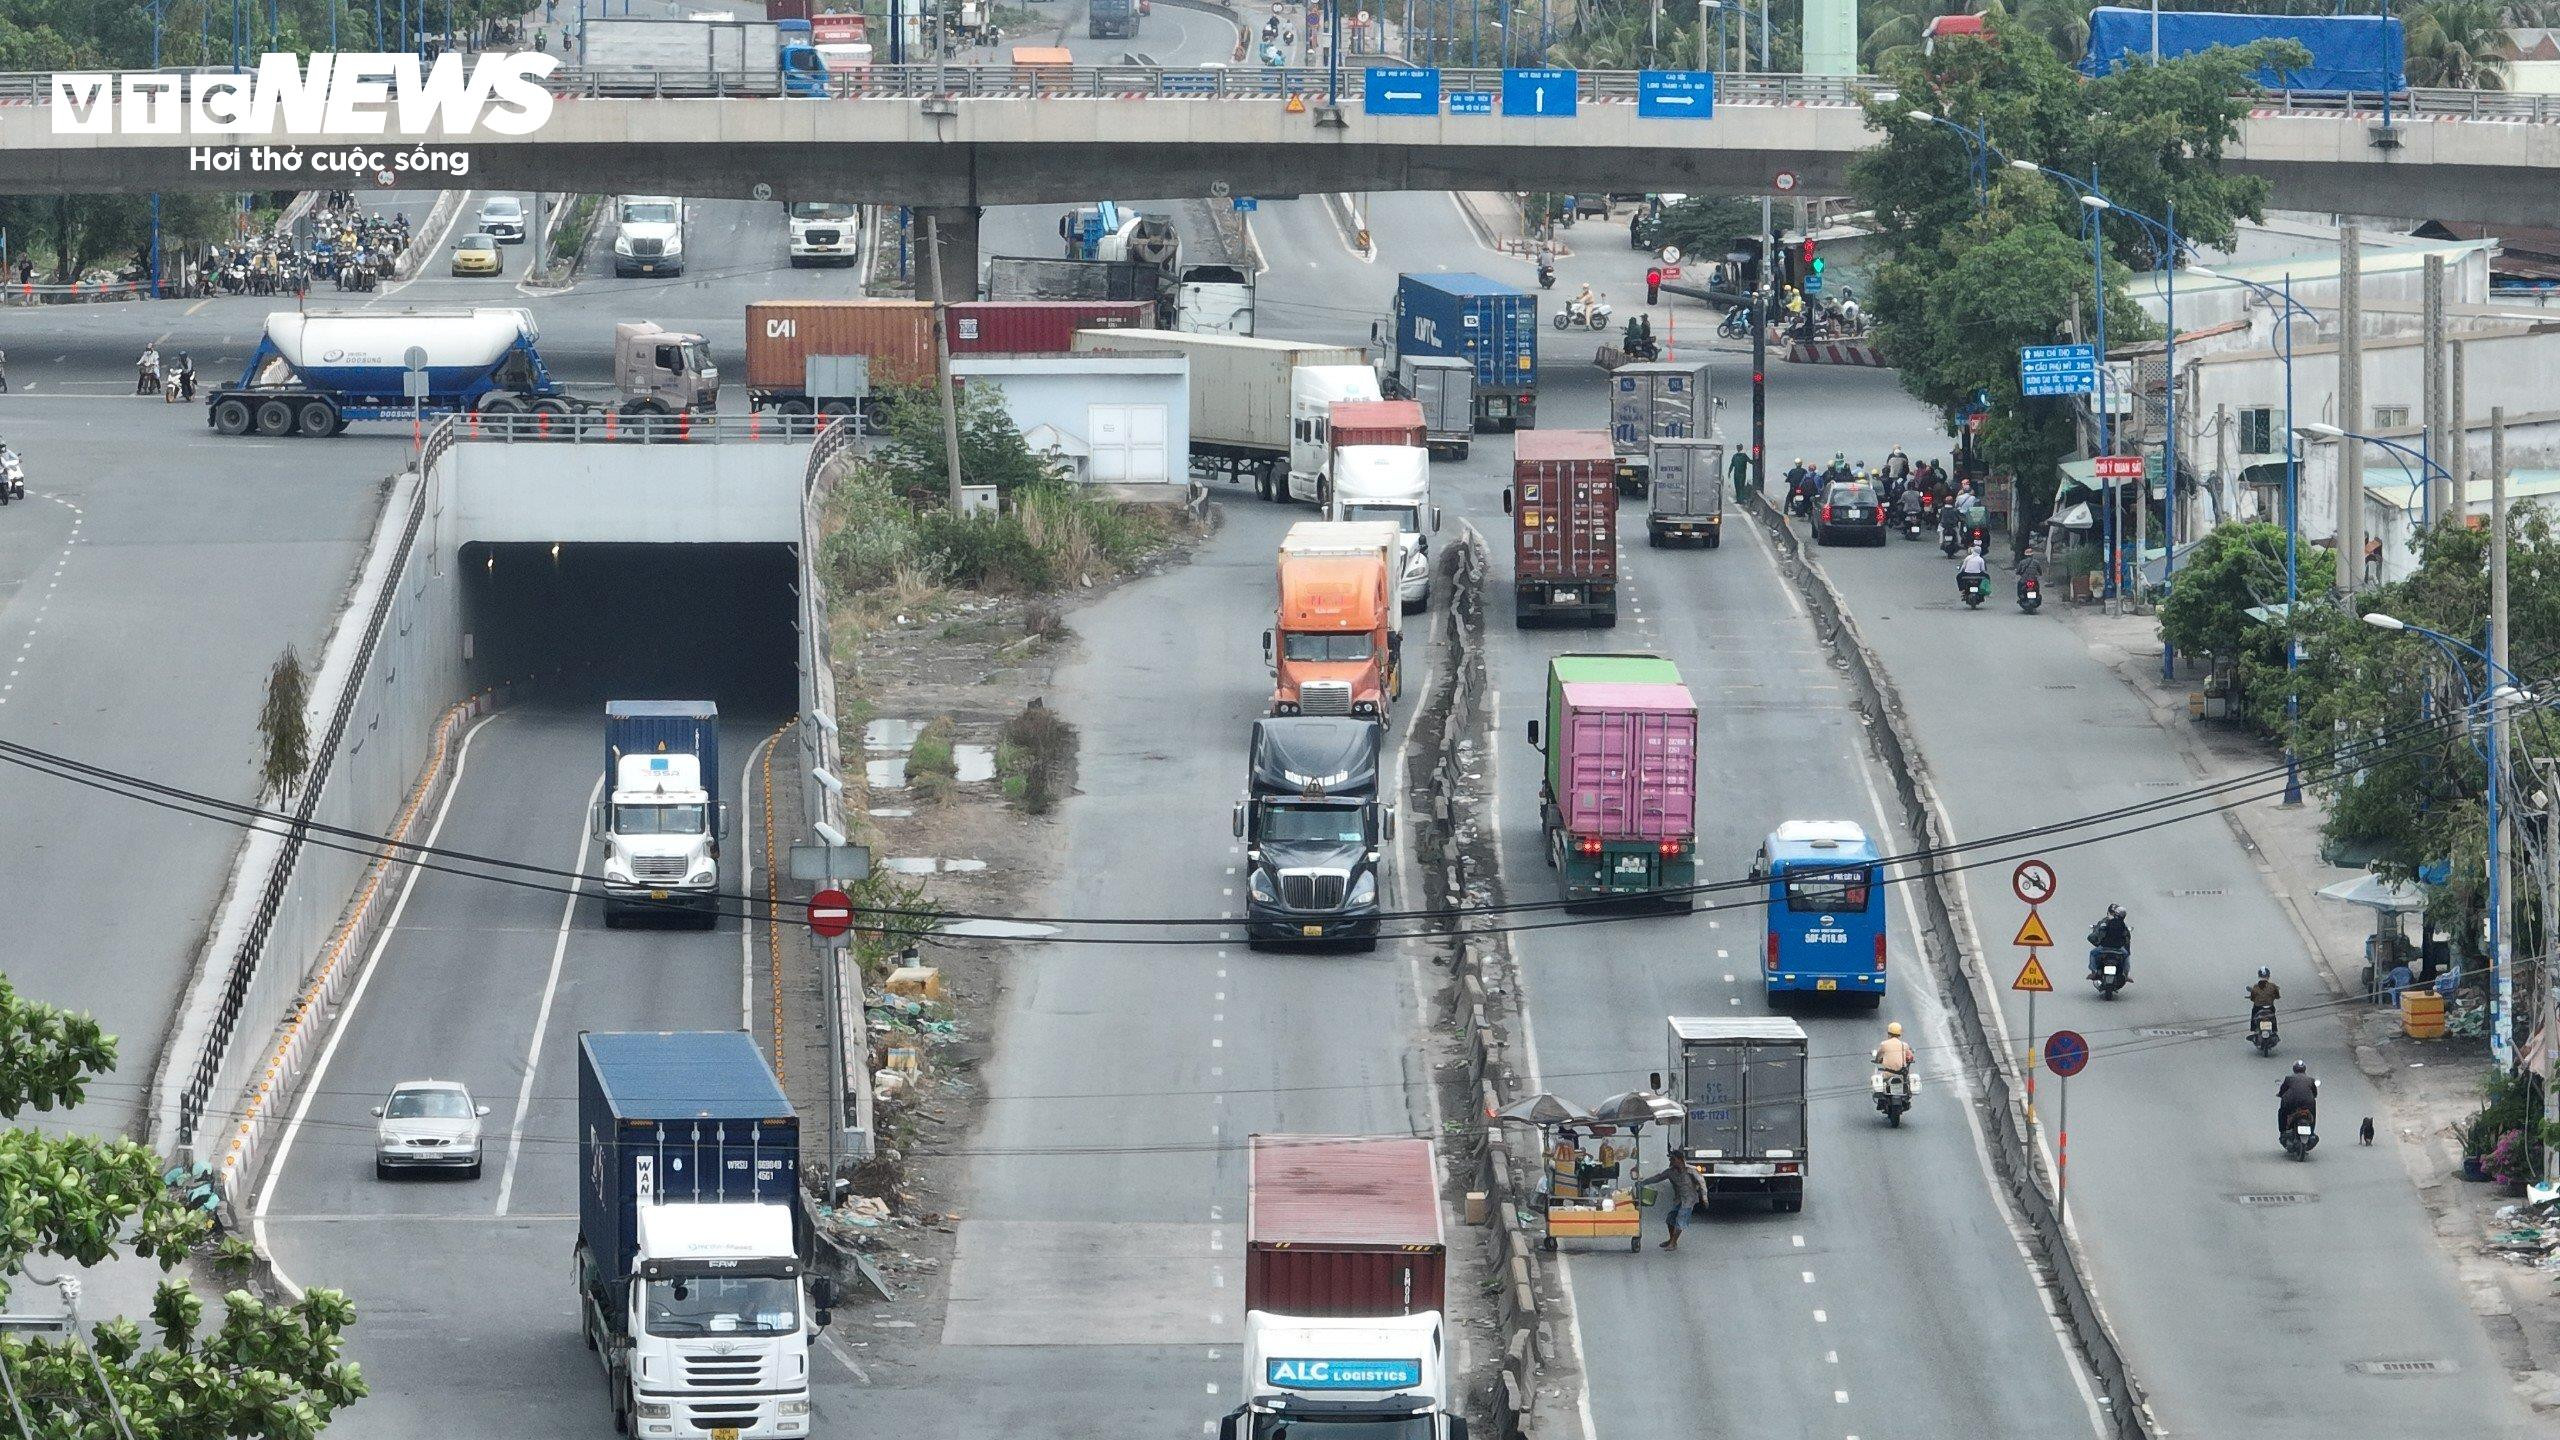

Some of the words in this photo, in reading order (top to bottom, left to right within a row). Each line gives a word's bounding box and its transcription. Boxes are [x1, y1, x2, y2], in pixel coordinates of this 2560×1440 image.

[766, 318, 796, 338] CAI
[708, 1259, 738, 1268] FAW
[1273, 1362, 1330, 1381] ALC
[1333, 1371, 1407, 1382] LOGISTICS
